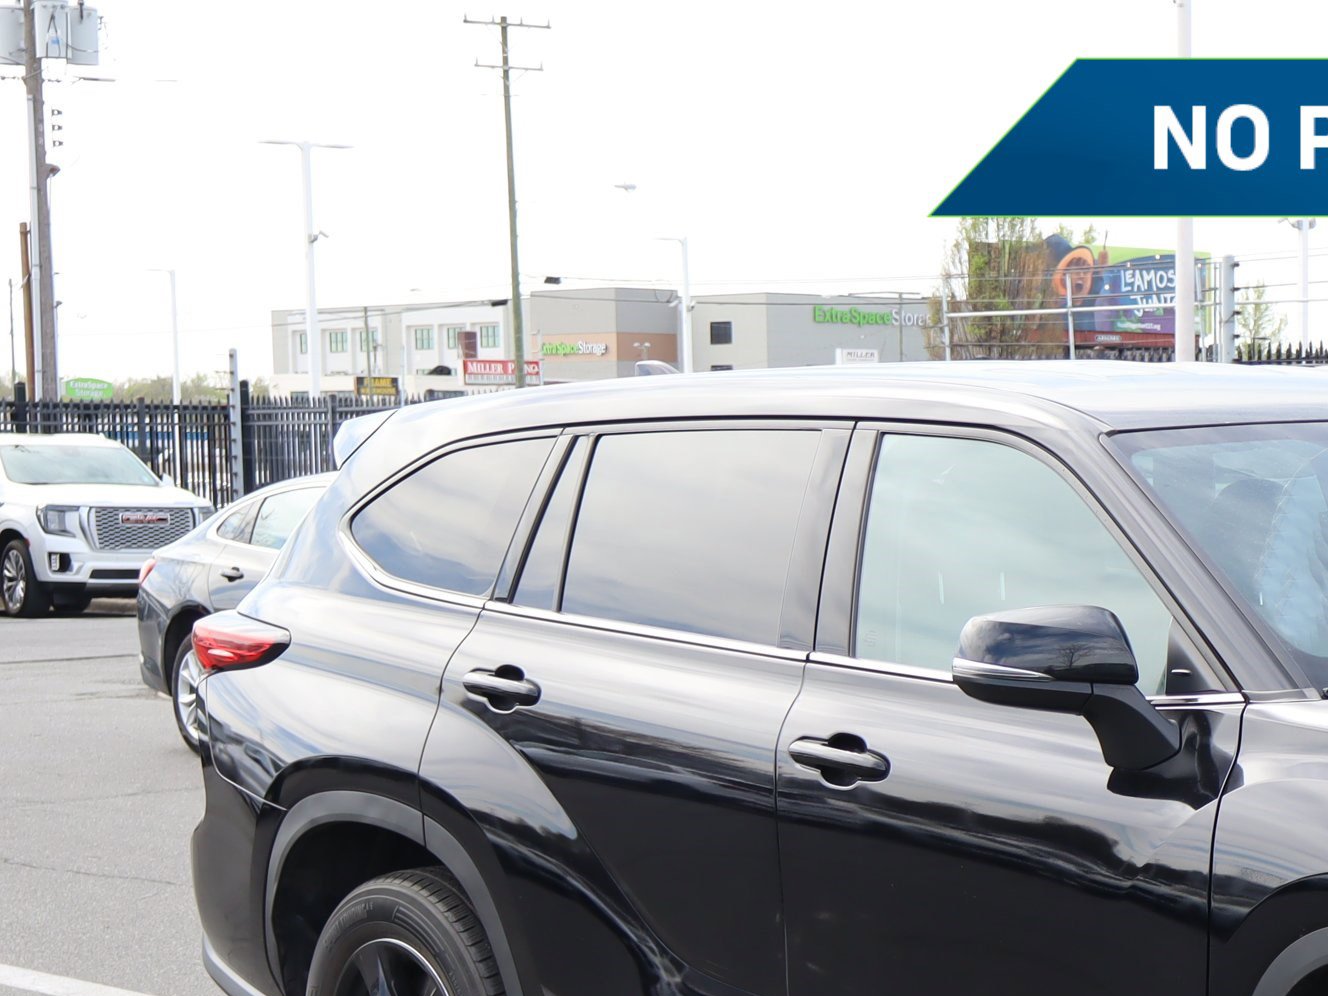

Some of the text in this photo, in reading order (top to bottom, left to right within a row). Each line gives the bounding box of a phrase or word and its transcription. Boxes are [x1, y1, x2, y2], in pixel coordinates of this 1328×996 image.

[1120, 269, 1176, 292] LEAMOS
[1130, 293, 1176, 317] JUNT
[467, 362, 539, 375] MILLER PNO
